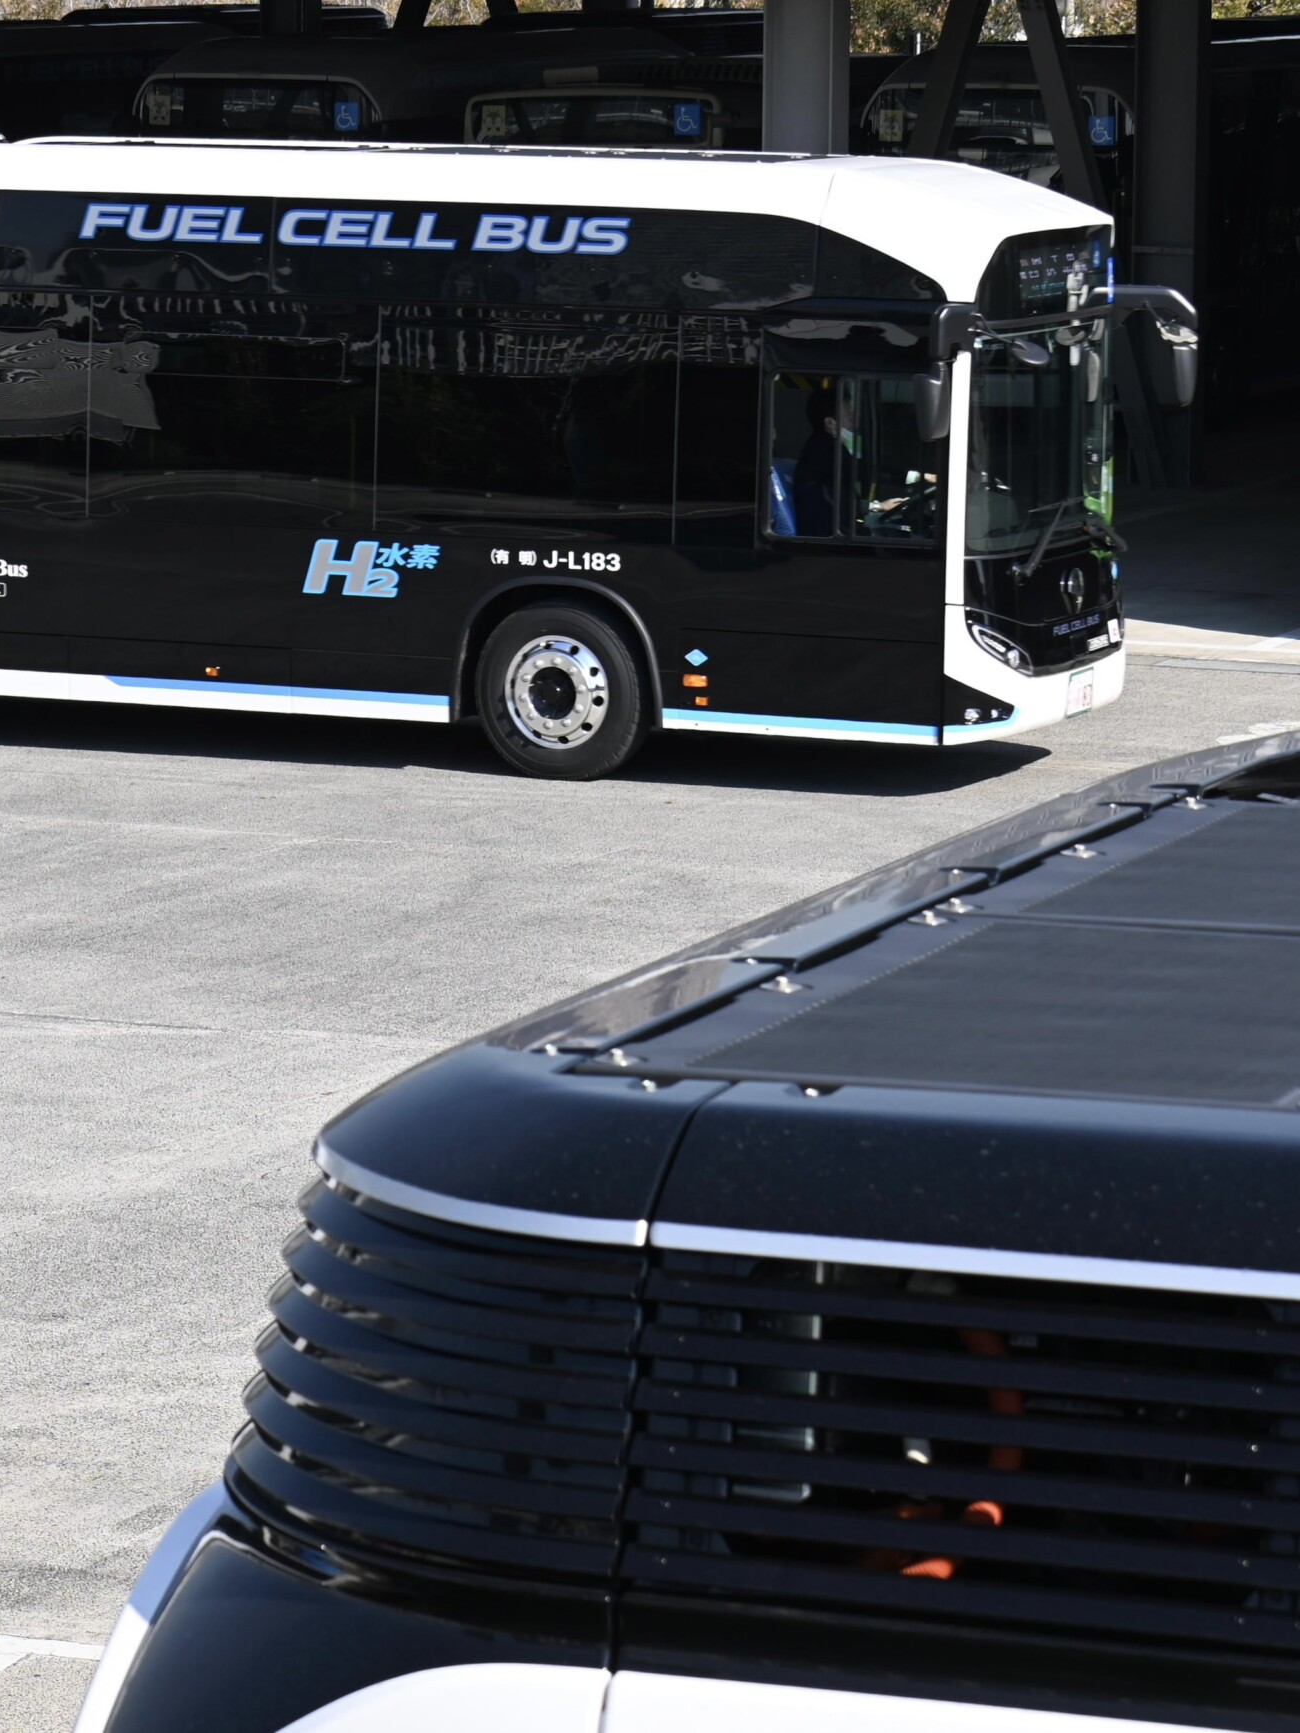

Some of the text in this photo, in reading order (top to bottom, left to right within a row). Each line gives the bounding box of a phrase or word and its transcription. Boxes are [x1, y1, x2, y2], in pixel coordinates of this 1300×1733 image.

[79, 203, 632, 255] FUEL CELL BUS
[375, 542, 441, 570] 水素
[543, 551, 621, 572] J-L183
